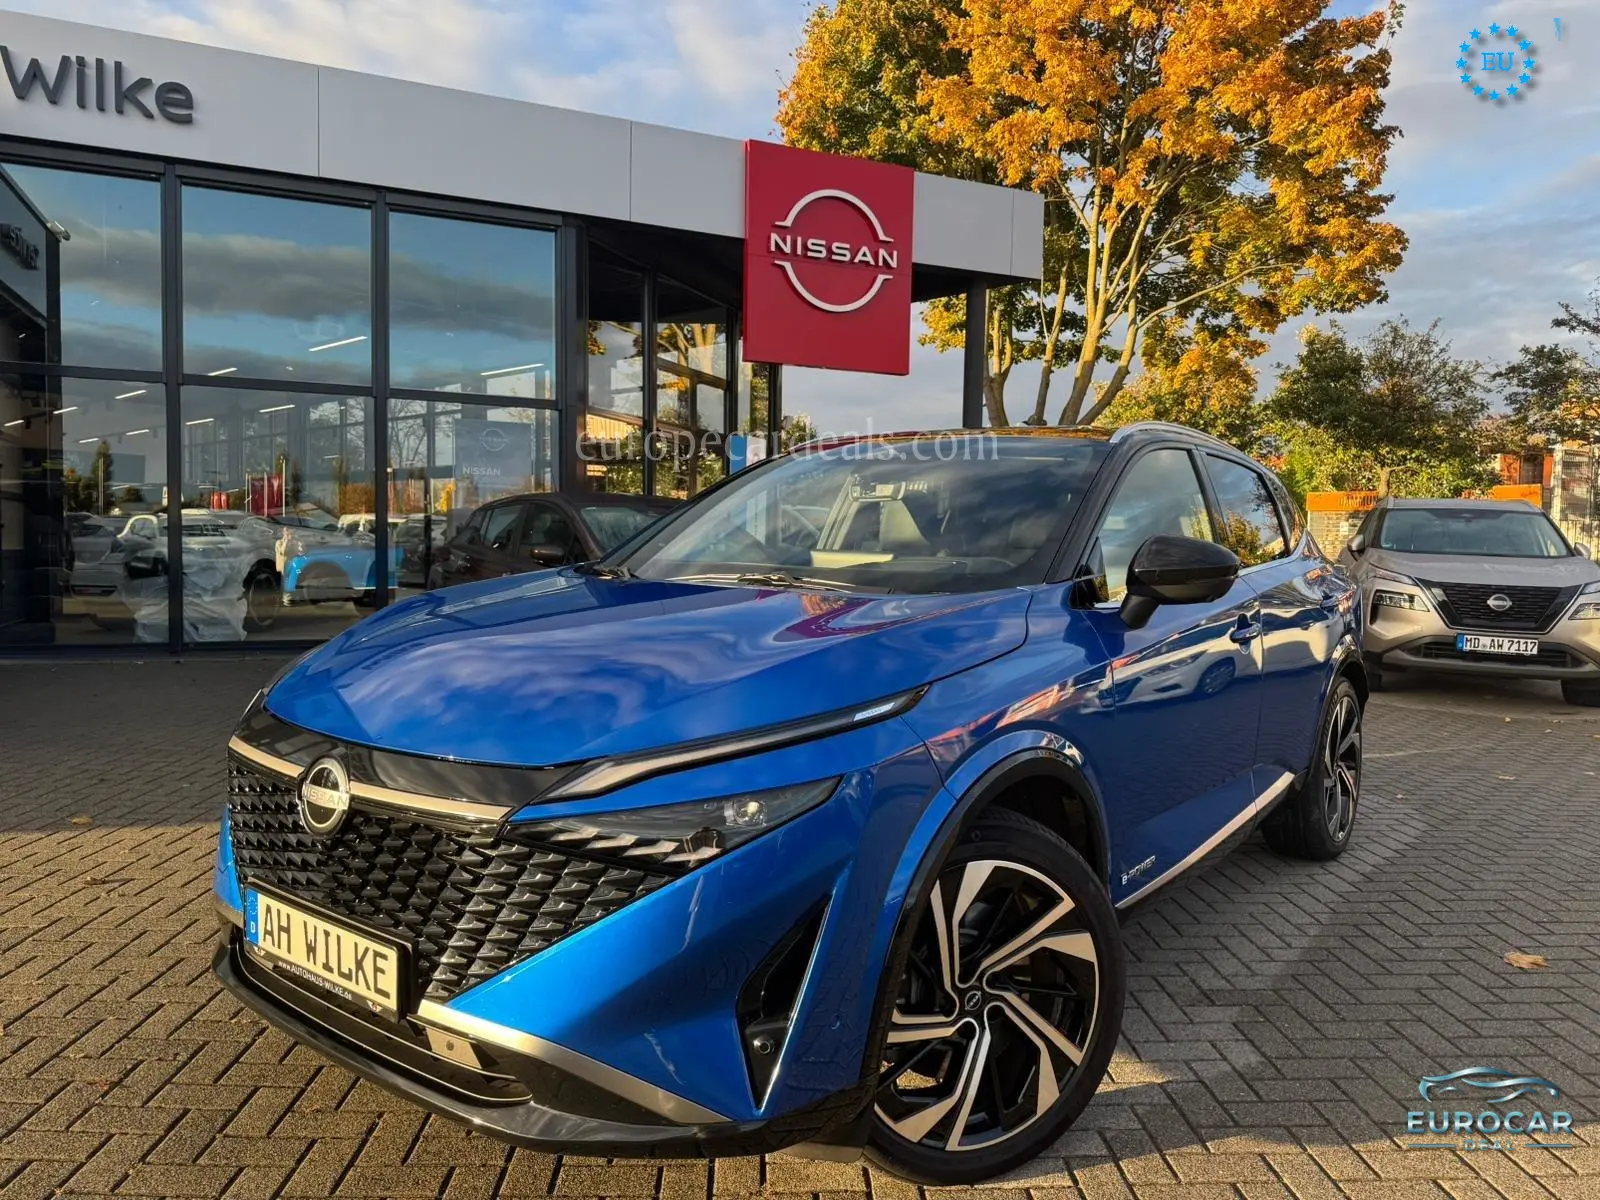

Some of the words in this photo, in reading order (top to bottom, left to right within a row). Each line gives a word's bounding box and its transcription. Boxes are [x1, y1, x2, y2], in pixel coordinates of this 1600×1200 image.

[0, 45, 194, 124] Wilke
[770, 232, 898, 268] NISSAN
[463, 465, 501, 476] NISSAN
[1464, 636, 1480, 649] MD
[1488, 638, 1504, 650] AW
[1507, 640, 1537, 653] 7117
[302, 782, 347, 808] NISSAN
[250, 921, 256, 934] D
[263, 903, 292, 955] AH
[303, 919, 391, 1000] WILKE
